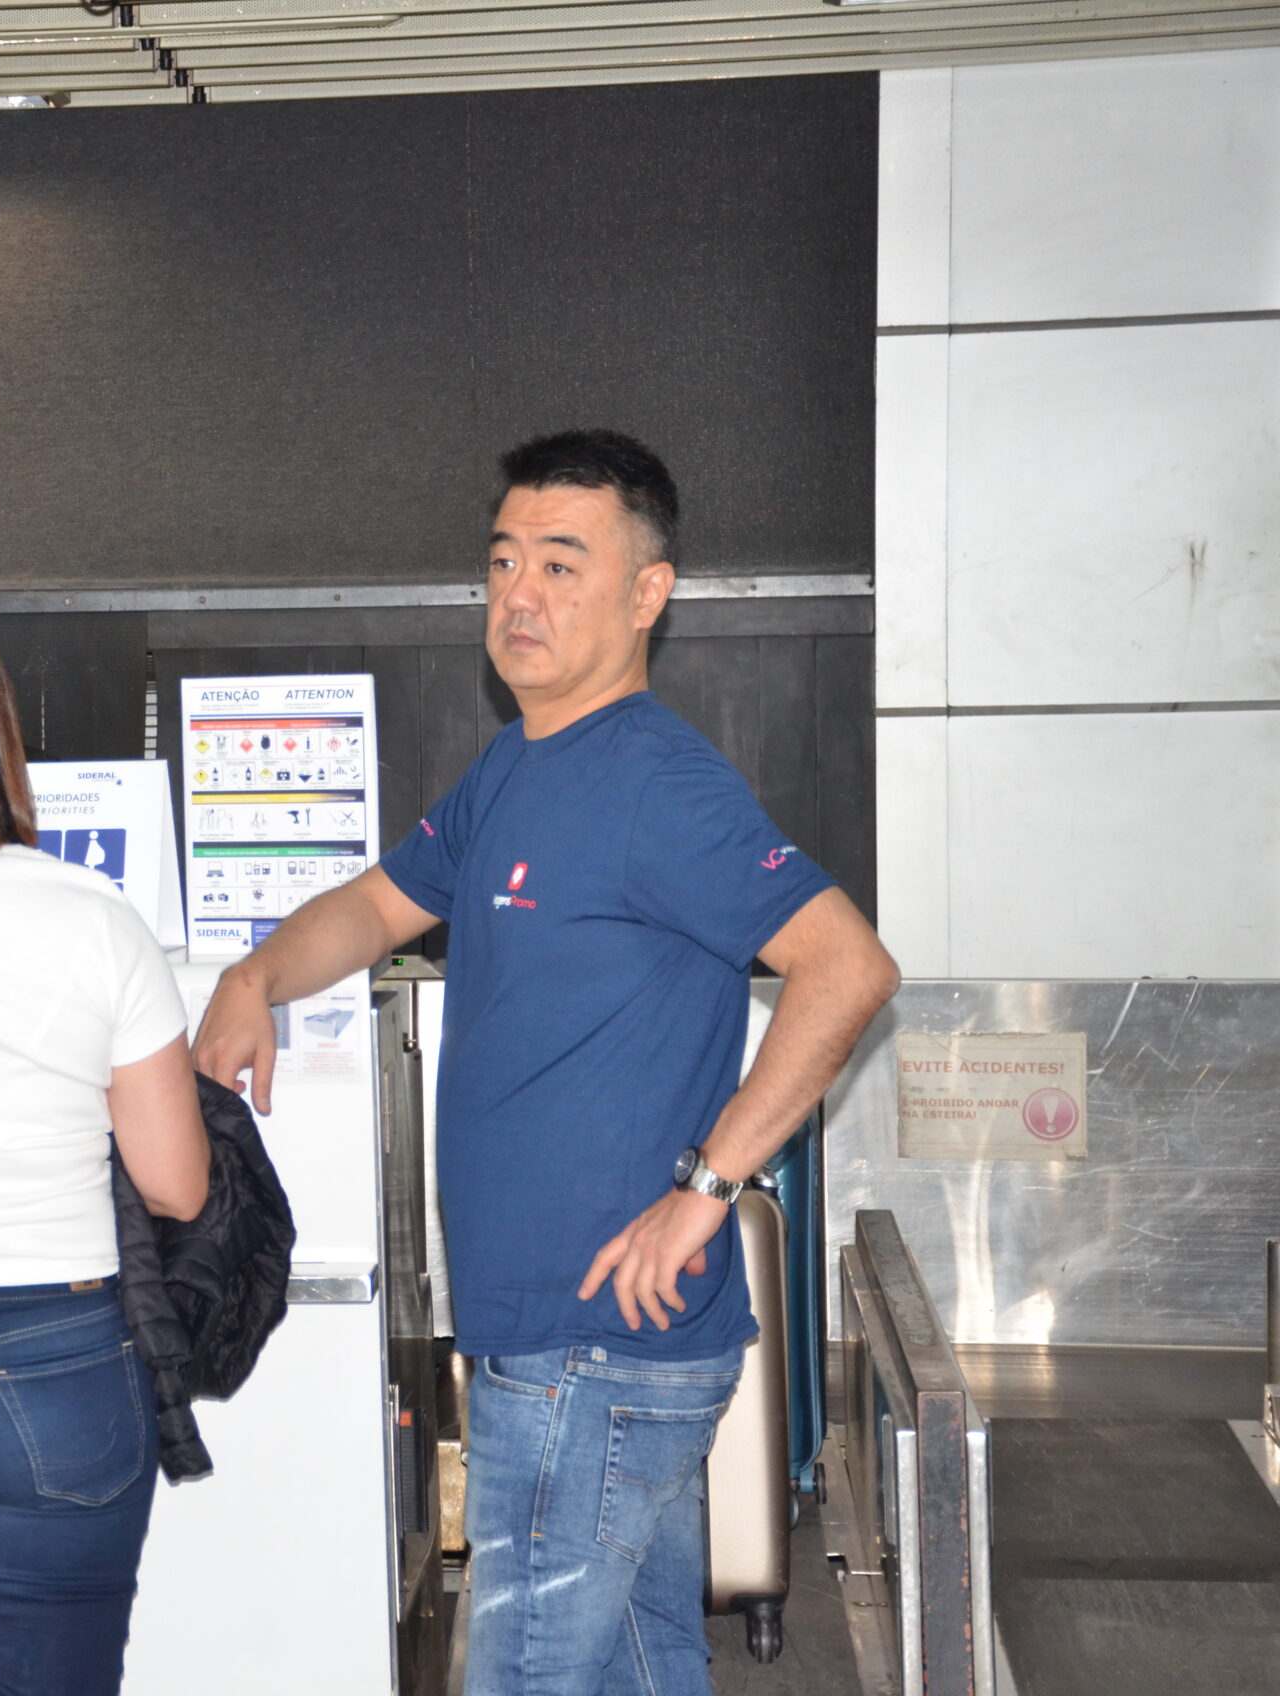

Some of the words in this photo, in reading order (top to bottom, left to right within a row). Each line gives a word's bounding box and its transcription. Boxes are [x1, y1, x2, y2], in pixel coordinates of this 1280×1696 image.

[201, 688, 260, 703] ATENÇÃO
[284, 688, 355, 700] ATTENTION
[77, 772, 116, 780] SIDERAL
[196, 928, 242, 938] SIDERAL
[902, 1061, 953, 1073] EVITE
[959, 1062, 1065, 1075] ACIDENTES!
[913, 1098, 974, 1108] PROIBIDO
[977, 1099, 1019, 1108] ANDAR
[922, 1111, 977, 1120] ESTEIRA!
